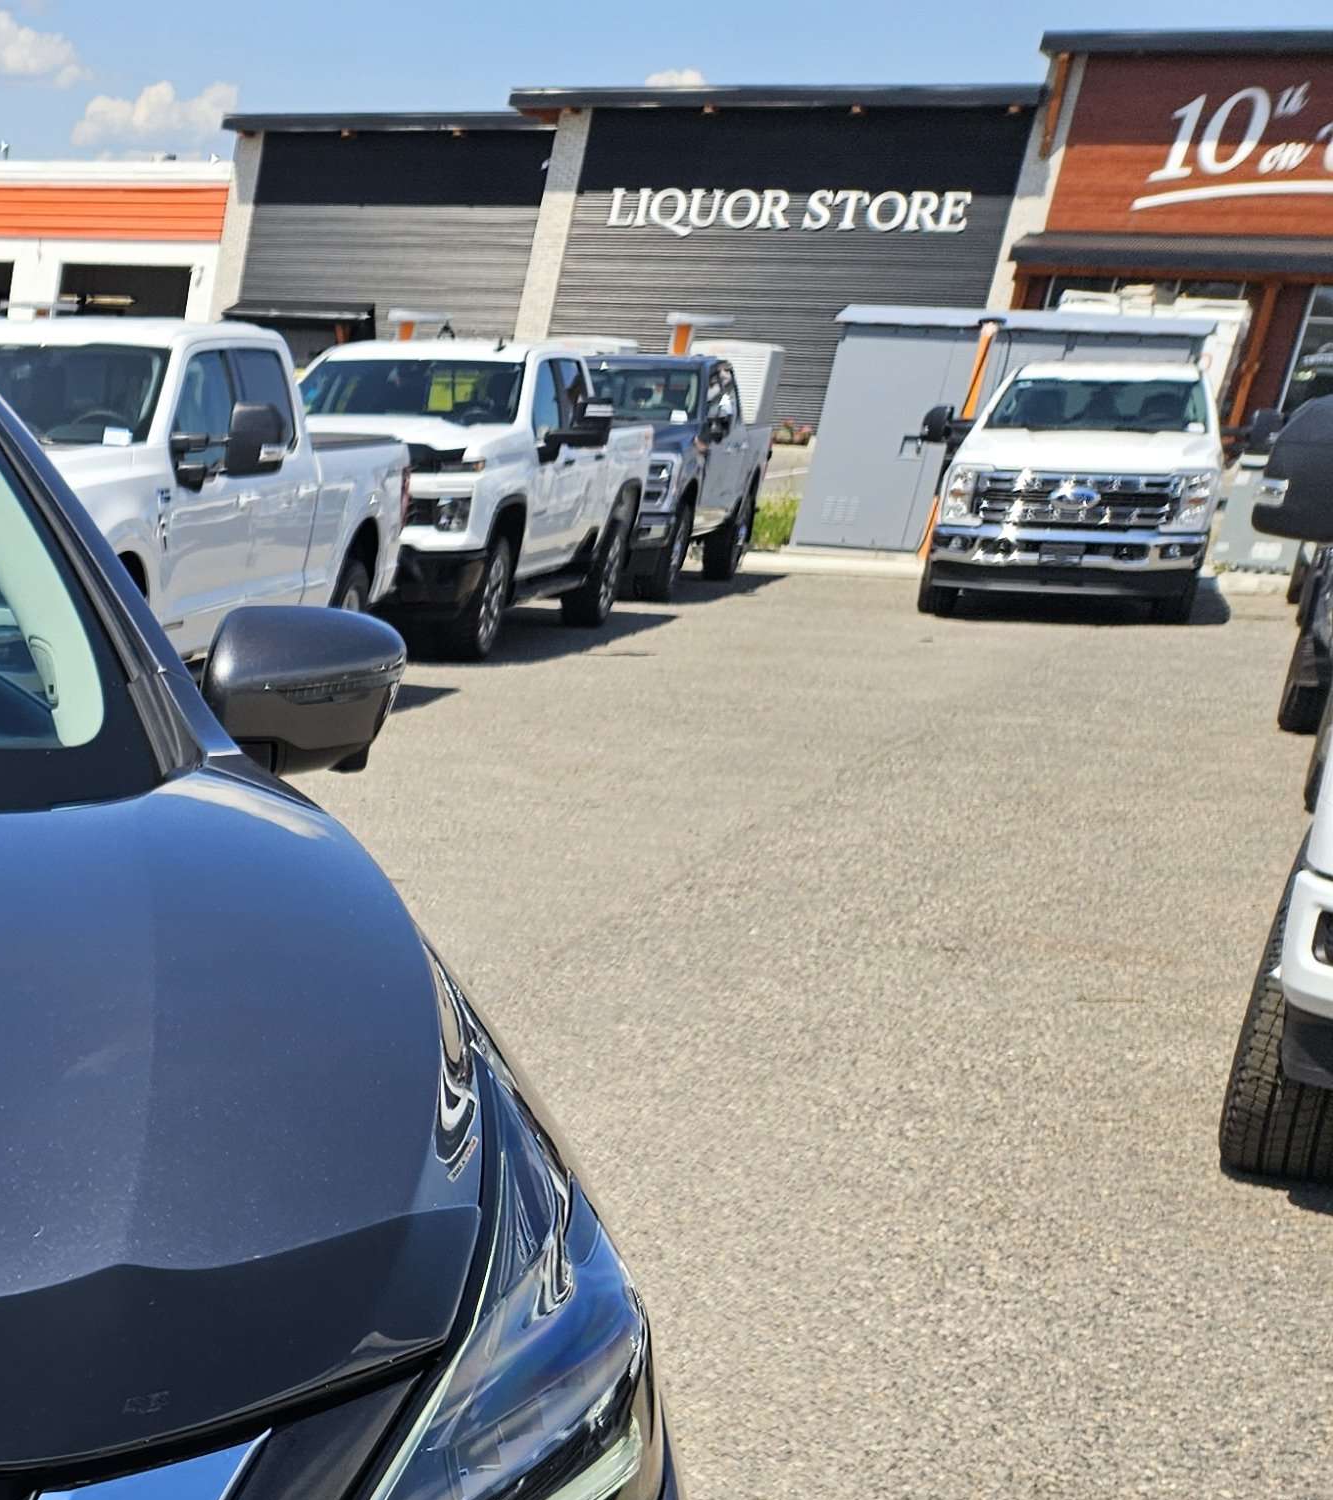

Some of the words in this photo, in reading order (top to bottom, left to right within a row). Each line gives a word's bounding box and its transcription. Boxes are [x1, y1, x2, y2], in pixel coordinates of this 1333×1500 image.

[1257, 141, 1315, 175] on
[605, 187, 791, 237] LIQUOR
[801, 189, 972, 234] STORE
